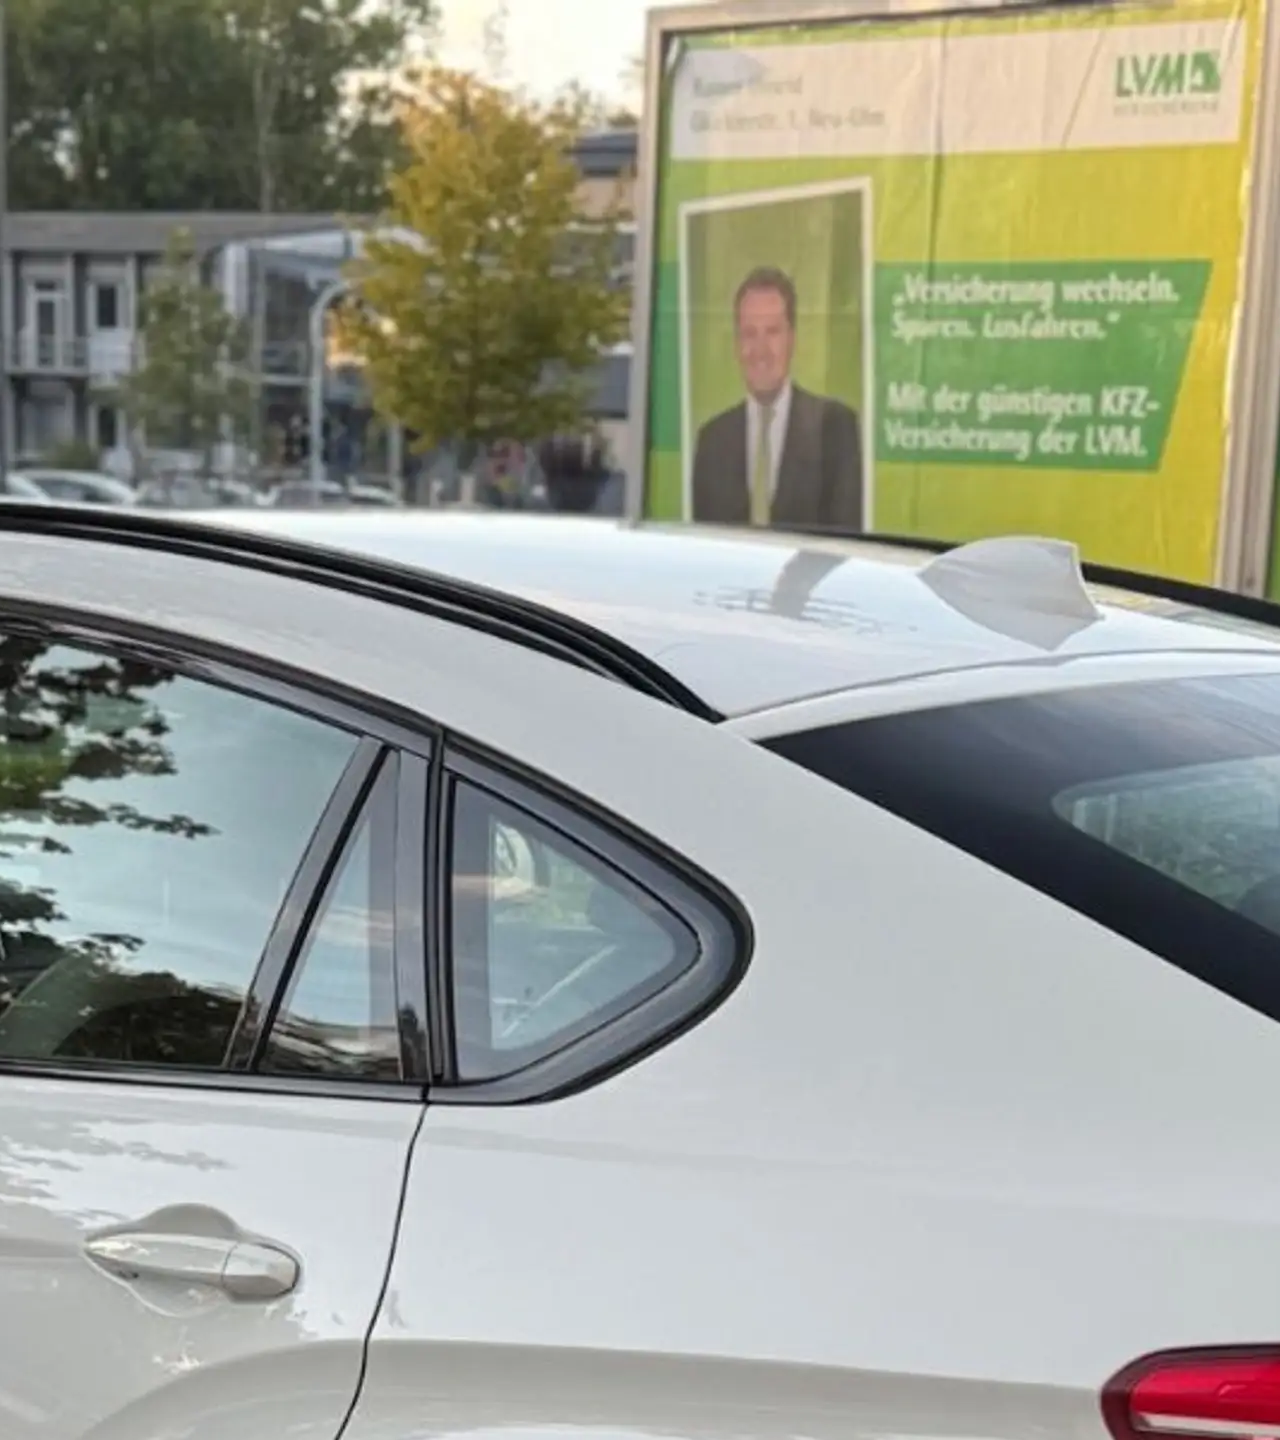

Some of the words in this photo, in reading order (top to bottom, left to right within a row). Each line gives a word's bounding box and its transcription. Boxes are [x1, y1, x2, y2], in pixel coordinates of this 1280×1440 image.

[1115, 52, 1186, 97] LVM
[1062, 271, 1180, 303] wechseln.
[886, 381, 927, 412] Mit
[932, 384, 972, 414] der
[977, 384, 1093, 424] günstigen
[1099, 385, 1160, 418] KFZ-
[883, 418, 1033, 461] Versicherung
[1036, 423, 1080, 455] der
[1084, 424, 1148, 457] LVM.
